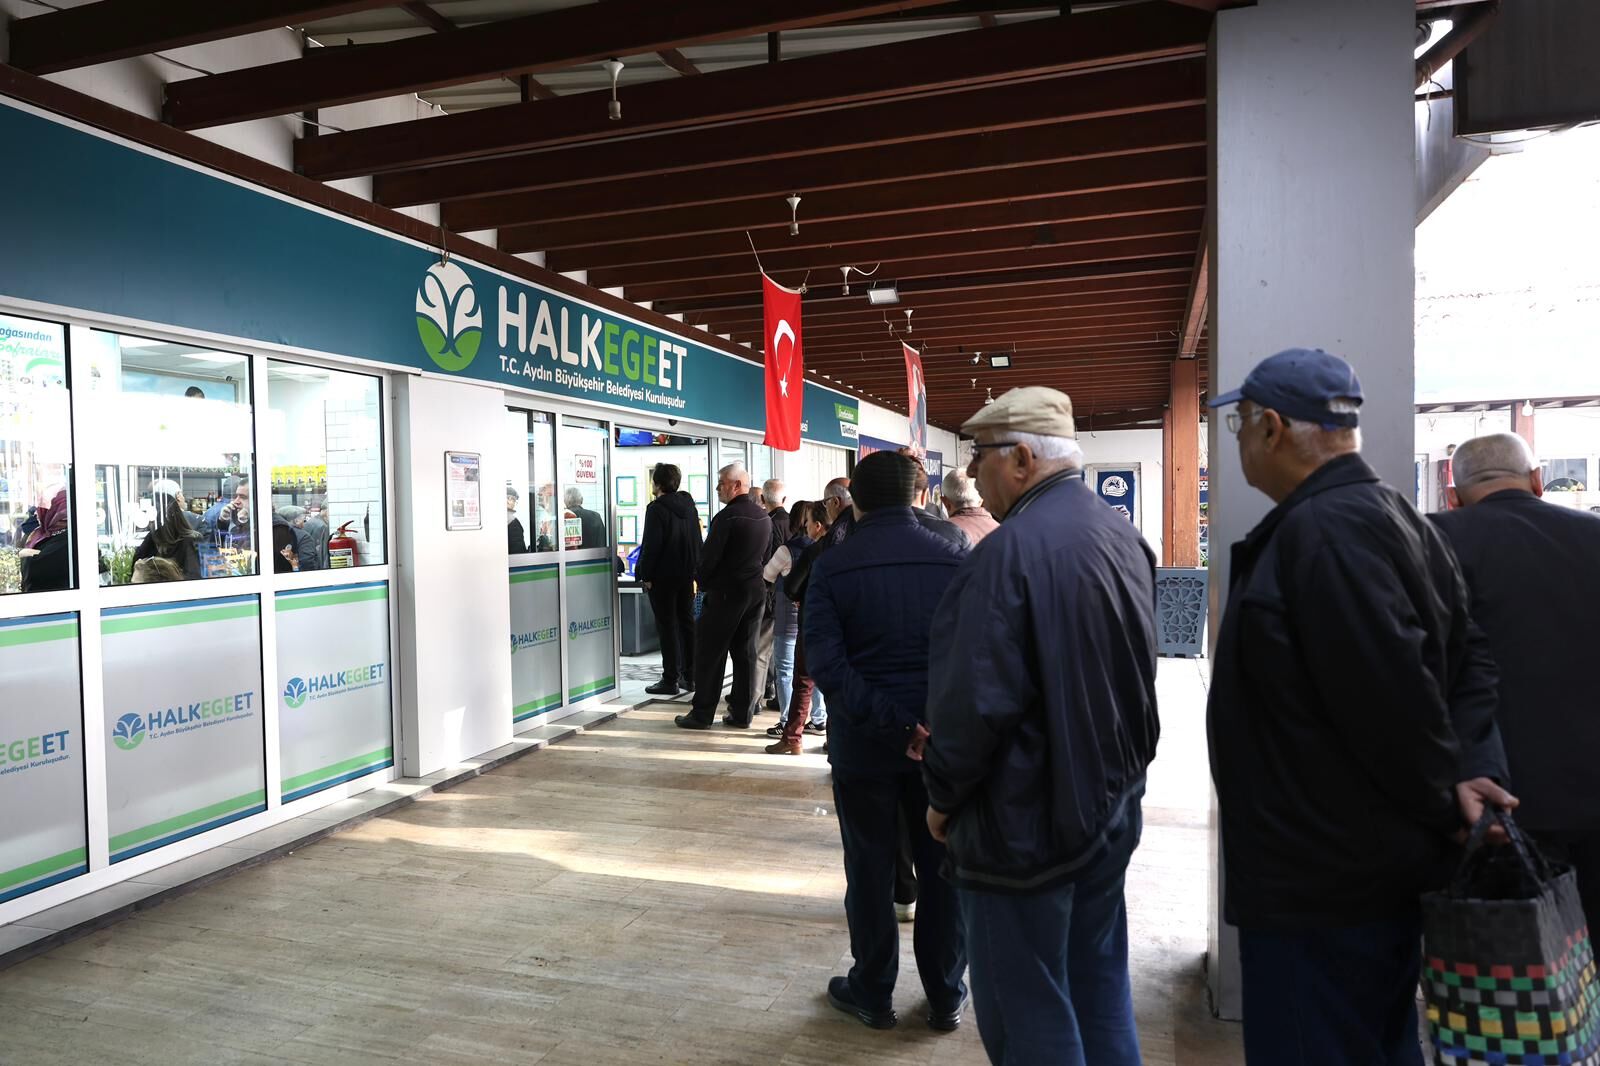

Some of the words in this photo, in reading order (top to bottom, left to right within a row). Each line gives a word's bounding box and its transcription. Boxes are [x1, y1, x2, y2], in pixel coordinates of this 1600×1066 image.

[498, 285, 687, 390] HALKEGEET
[499, 355, 520, 375] T.C.
[523, 361, 552, 382] Aydın
[555, 368, 604, 393] Büyükşehir
[606, 380, 644, 402] Belediyesi
[645, 389, 686, 409] Kuruluşudur
[518, 627, 557, 645] HALKEGEET
[579, 616, 611, 631] HALKEGEET
[309, 663, 384, 693] HALKEGEET
[148, 691, 253, 731] HALKEGEET
